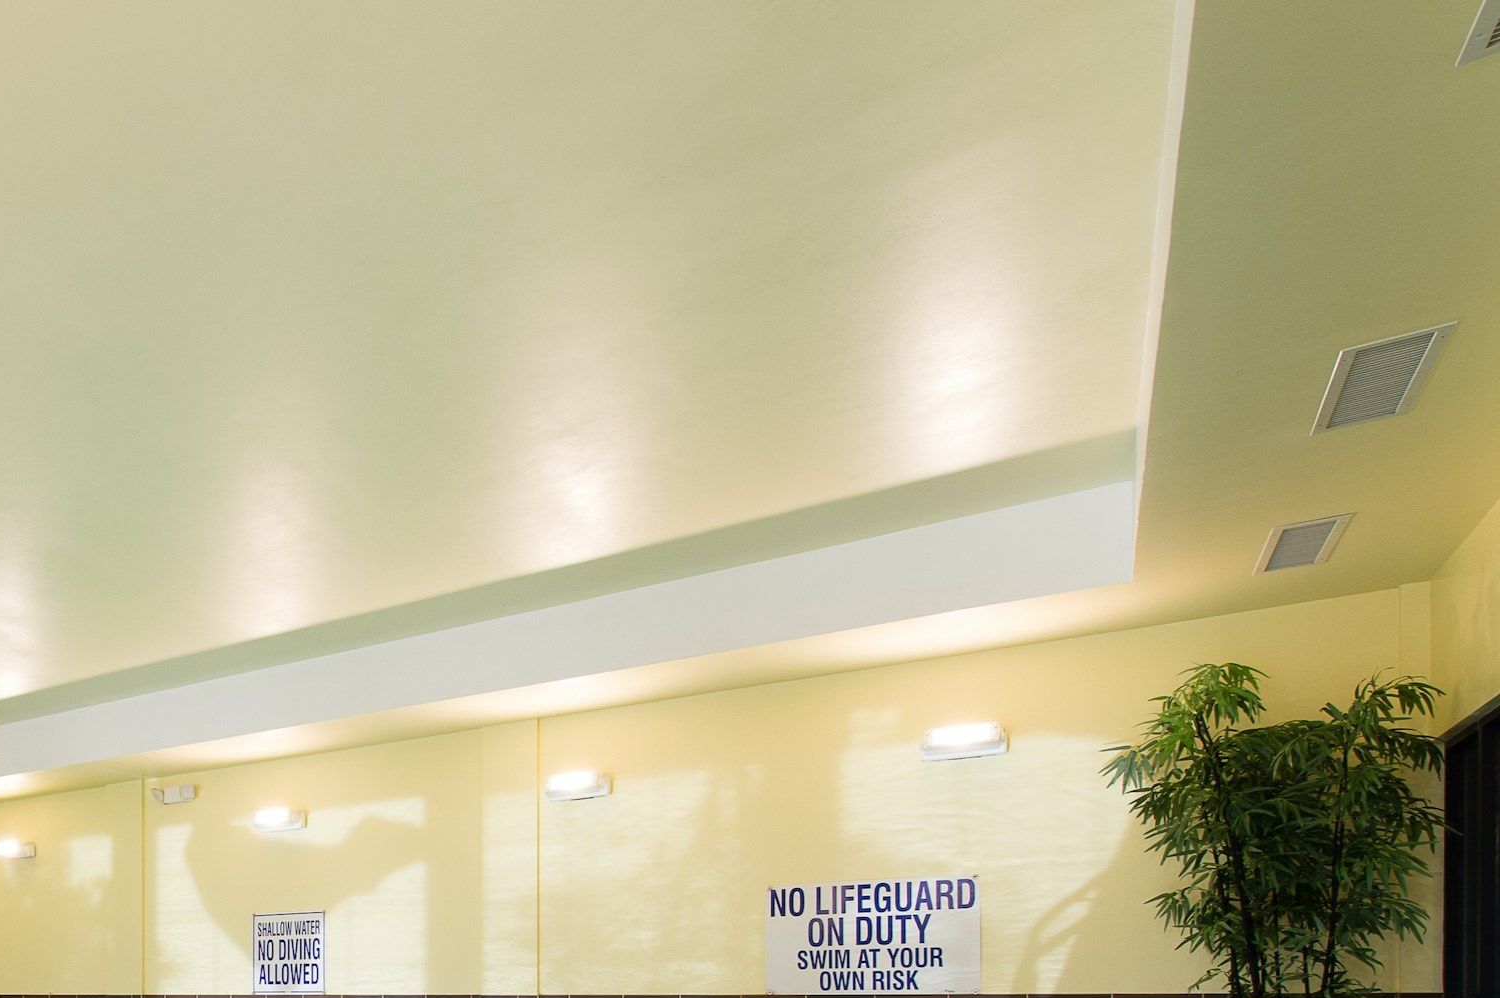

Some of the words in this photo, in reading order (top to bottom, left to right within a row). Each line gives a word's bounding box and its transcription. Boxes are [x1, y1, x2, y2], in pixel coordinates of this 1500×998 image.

[770, 887, 805, 917] NO
[816, 878, 976, 915] LIFEGUARD
[257, 921, 292, 937] SHALLOW
[294, 920, 320, 936] WATER
[808, 917, 844, 947] ON
[855, 914, 931, 945] DUTY
[258, 939, 274, 961] NO
[279, 938, 320, 961] DIVING
[797, 949, 850, 970] SWIM
[857, 949, 880, 969] AT
[887, 947, 943, 968] YOUR
[259, 963, 319, 985] ALLOWED
[819, 971, 864, 991] OWN
[872, 970, 919, 991] RISK
